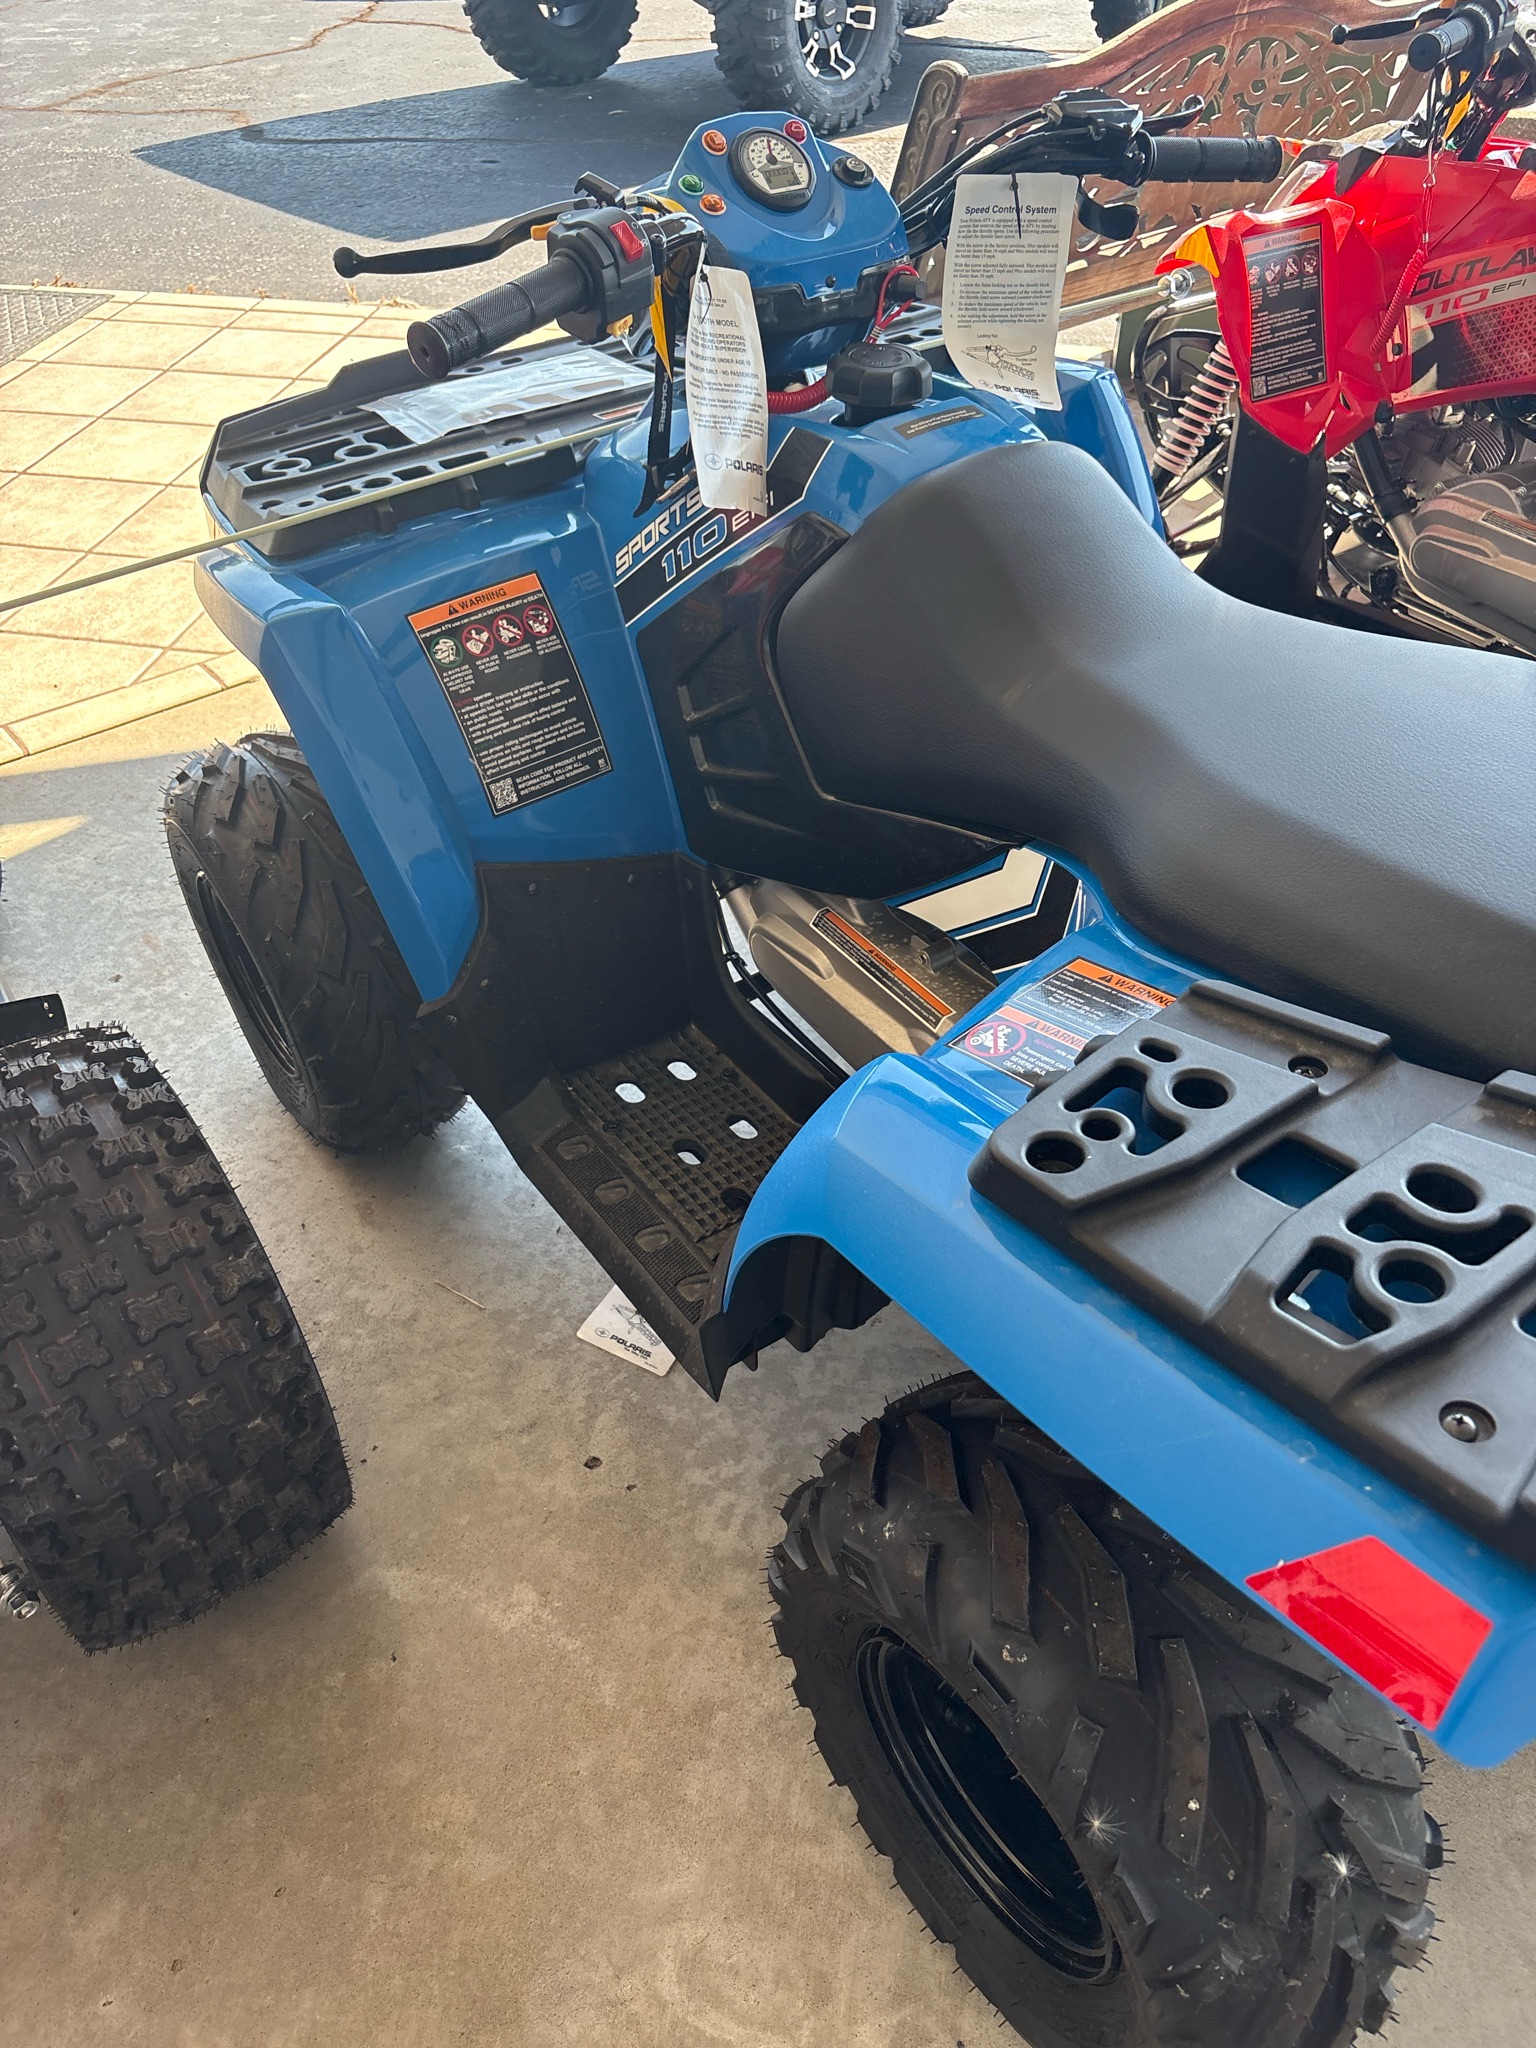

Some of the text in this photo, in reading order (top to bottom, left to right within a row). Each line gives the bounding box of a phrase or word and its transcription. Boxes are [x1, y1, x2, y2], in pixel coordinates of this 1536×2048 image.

[965, 205, 1057, 215] Speed Contrl System
[1272, 233, 1299, 245] WARNING
[1423, 279, 1527, 319] 110 EFI
[716, 319, 739, 327] MODEL
[709, 333, 746, 341] RECREATIONAL
[716, 339, 745, 347] OPERATORS
[994, 384, 1039, 396] POLARIS
[658, 372, 668, 433] POLARIS
[726, 456, 764, 476] POLARIS
[662, 514, 728, 582] 110
[458, 587, 506, 610] WARNING
[420, 627, 442, 639] Improper
[441, 623, 452, 631] ATV
[469, 613, 483, 621] result
[486, 605, 505, 615] SEVERE
[505, 599, 523, 609] INJURY
[527, 592, 543, 601] DEATH
[535, 637, 549, 645] NEVER
[546, 638, 560, 647] DRUGS
[503, 642, 531, 656] NEVER CARRY
[506, 647, 533, 661] PASSENGERS
[544, 643, 562, 653] ALCOHOL
[475, 657, 489, 665] NEVER
[485, 659, 500, 668] PUBLIC
[442, 667, 460, 677] ALWAYS
[449, 669, 472, 680] APPROVED
[484, 665, 499, 673] ROADS
[446, 677, 464, 687] HELMET
[449, 679, 475, 692] PROTECTIVE
[458, 686, 471, 694] GEAR
[515, 774, 530, 783] SCAN
[529, 768, 544, 777] CODE
[543, 764, 554, 772] FOR
[554, 755, 577, 768] PRODUCT
[586, 745, 603, 755] SAFETY
[552, 764, 573, 775] FOLLOW
[519, 778, 555, 795] INSTRUCTIONS
[874, 953, 896, 971] WARNING
[1041, 1024, 1086, 1048] WARNI
[1010, 1056, 1034, 1070] SEVERE
[1023, 1047, 1067, 1070] Passengers can
[1035, 1060, 1056, 1071] control
[610, 1335, 652, 1358] POLARIS
